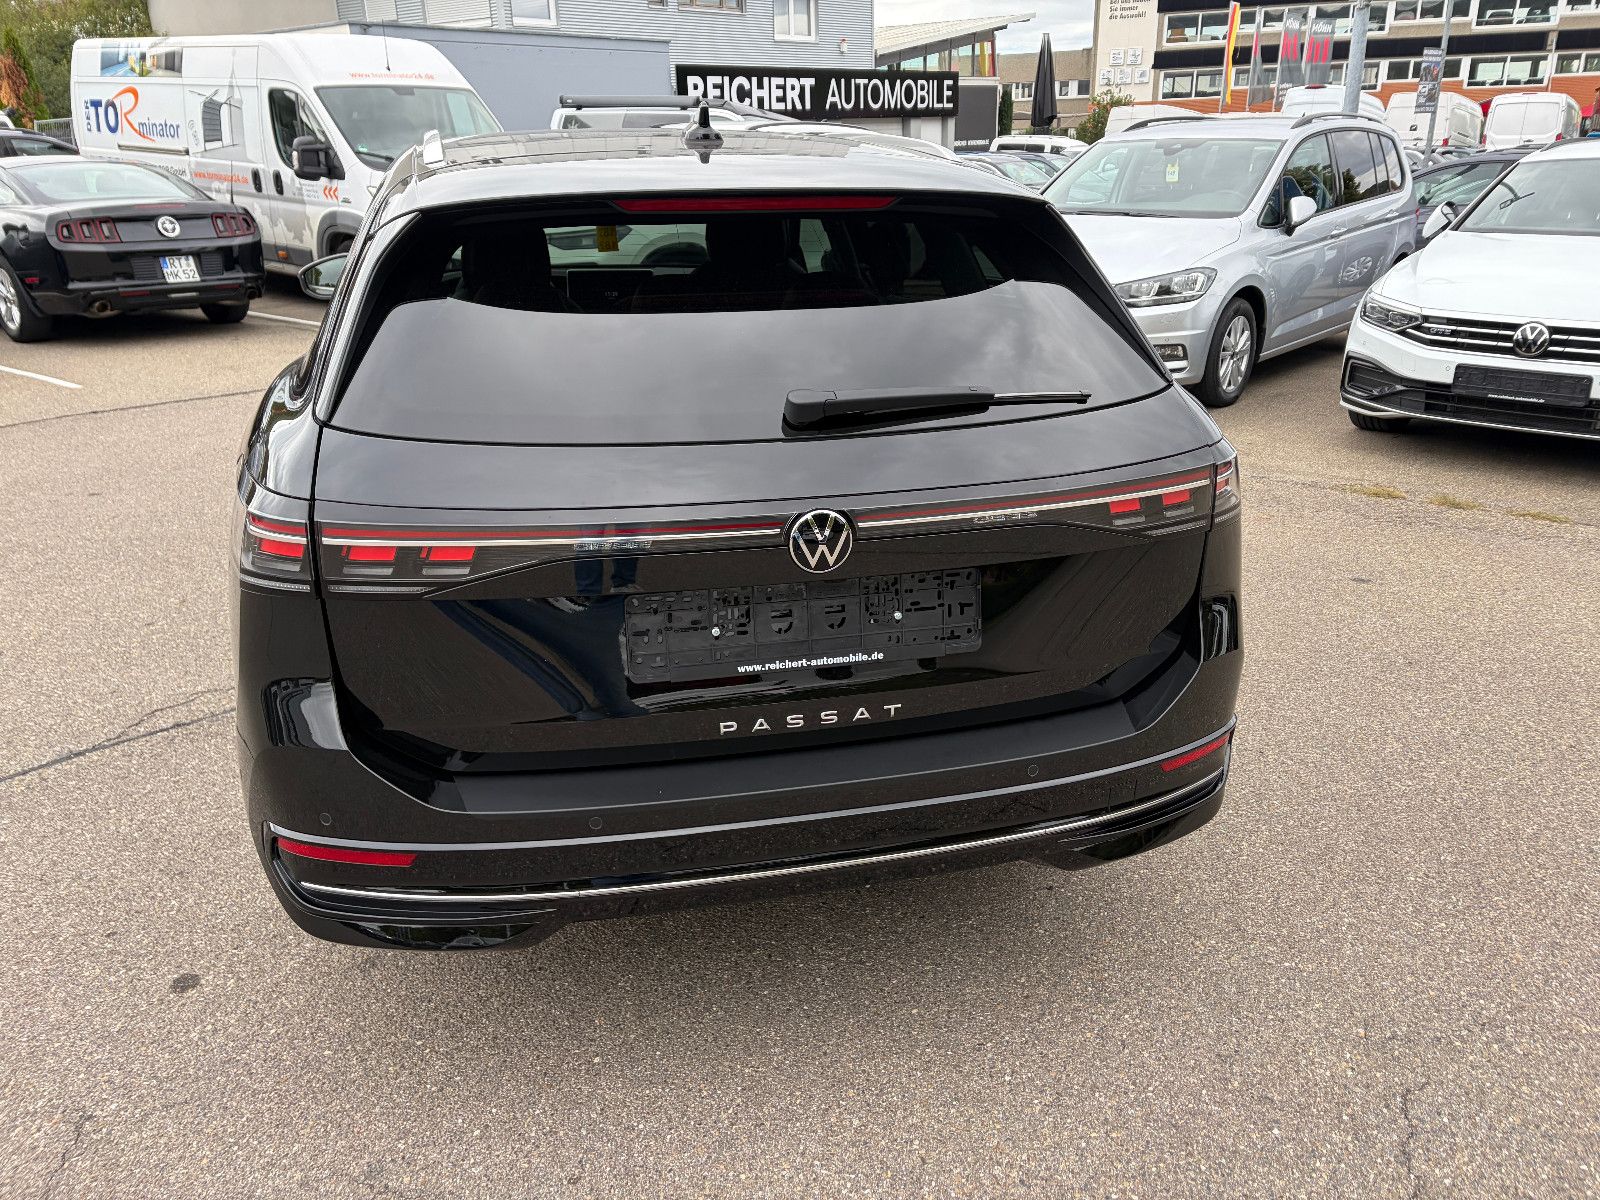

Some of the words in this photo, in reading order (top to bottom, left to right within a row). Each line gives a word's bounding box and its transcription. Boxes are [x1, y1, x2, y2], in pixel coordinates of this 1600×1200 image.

[686, 75, 815, 110] REICHERT
[825, 79, 954, 109] AUTOMOBILE
[84, 99, 92, 132] DER
[166, 270, 182, 281] MK
[182, 269, 198, 279] 52
[737, 651, 884, 673] www.reichert-automobile.de
[719, 703, 902, 736] PASSAT
